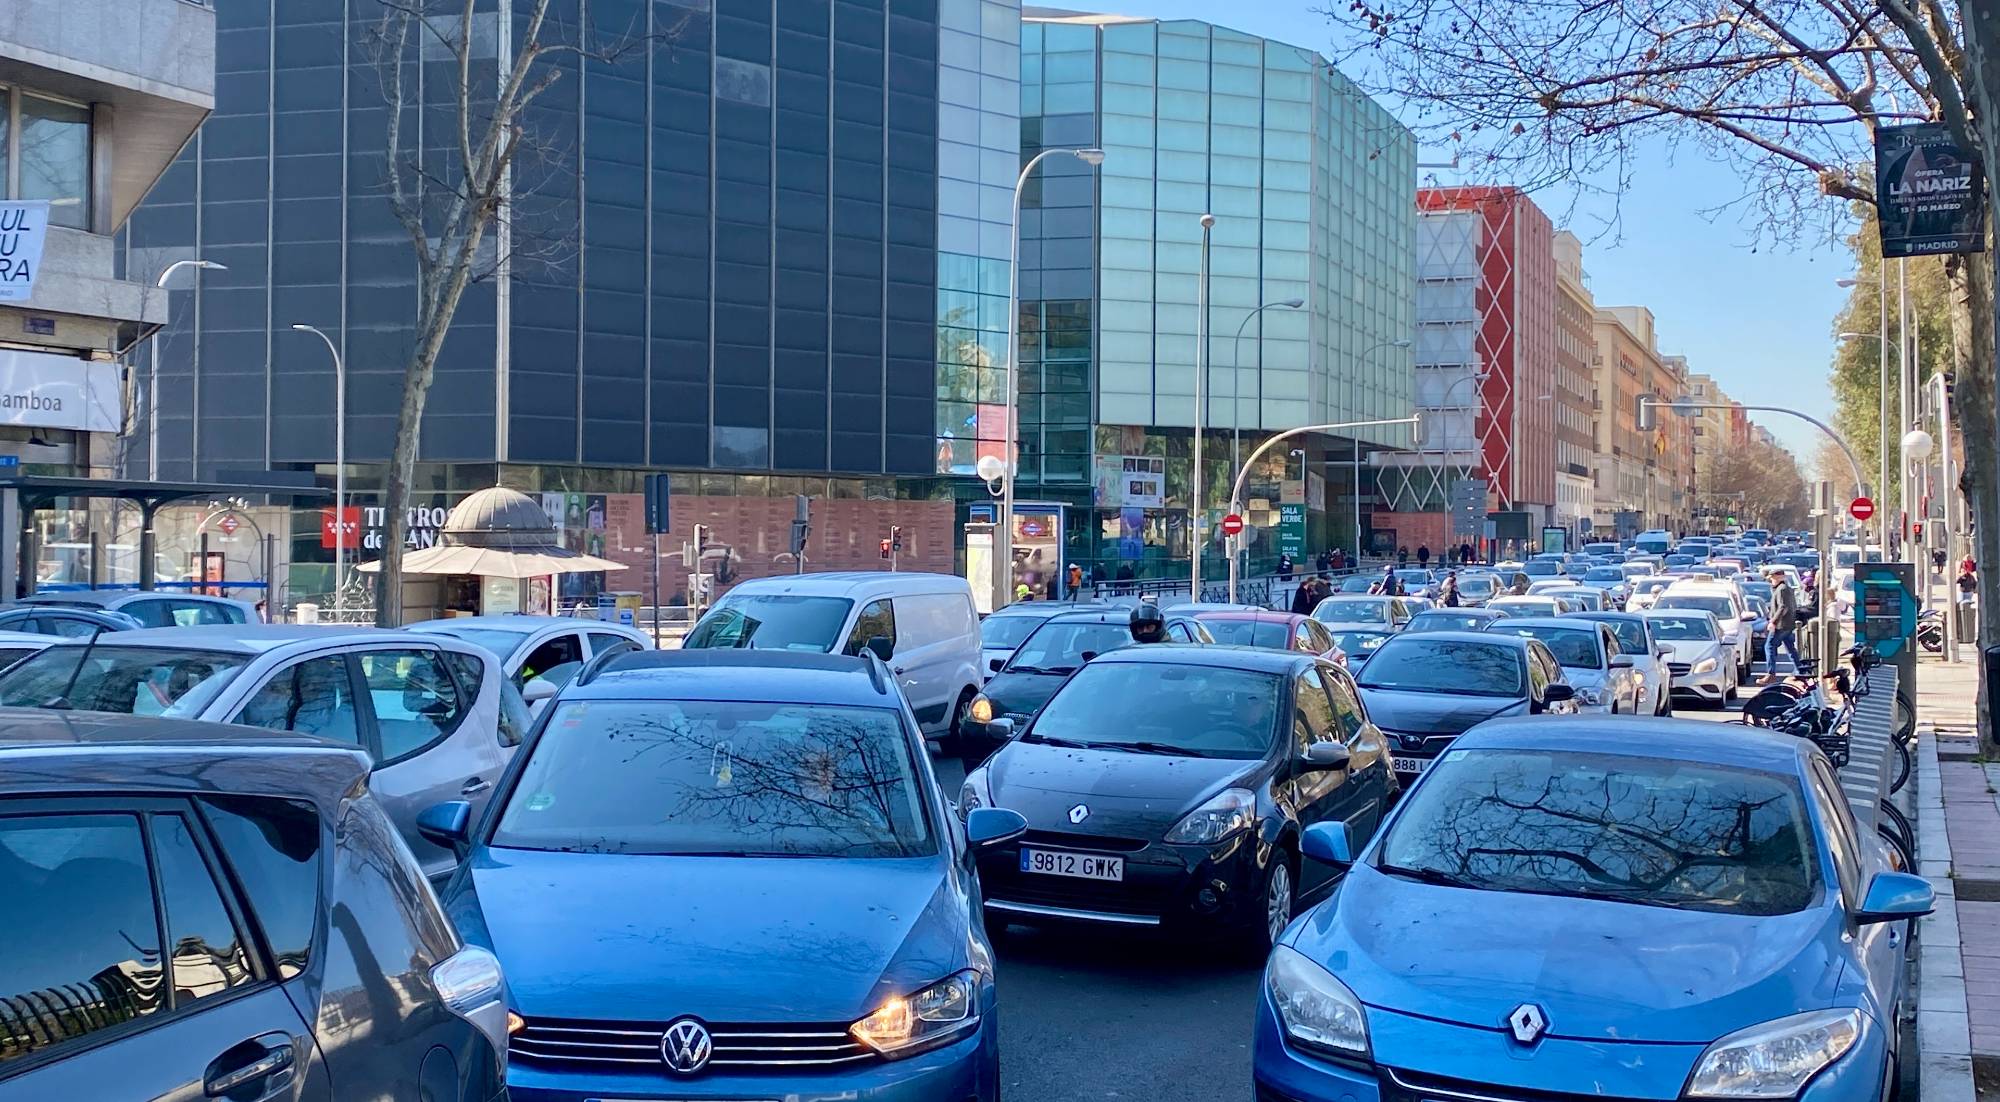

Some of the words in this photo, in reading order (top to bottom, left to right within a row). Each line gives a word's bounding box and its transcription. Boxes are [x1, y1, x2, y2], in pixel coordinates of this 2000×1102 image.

[1889, 182, 1913, 196] LA
[1916, 177, 1971, 193] NARIZ
[1929, 202, 1961, 212] MARZO
[0, 233, 19, 256] U
[1917, 240, 1959, 252] MADRID
[0, 258, 30, 282] RA
[1, 391, 61, 410] amboa
[1034, 852, 1075, 875] 9812
[1082, 857, 1119, 878] GWK
